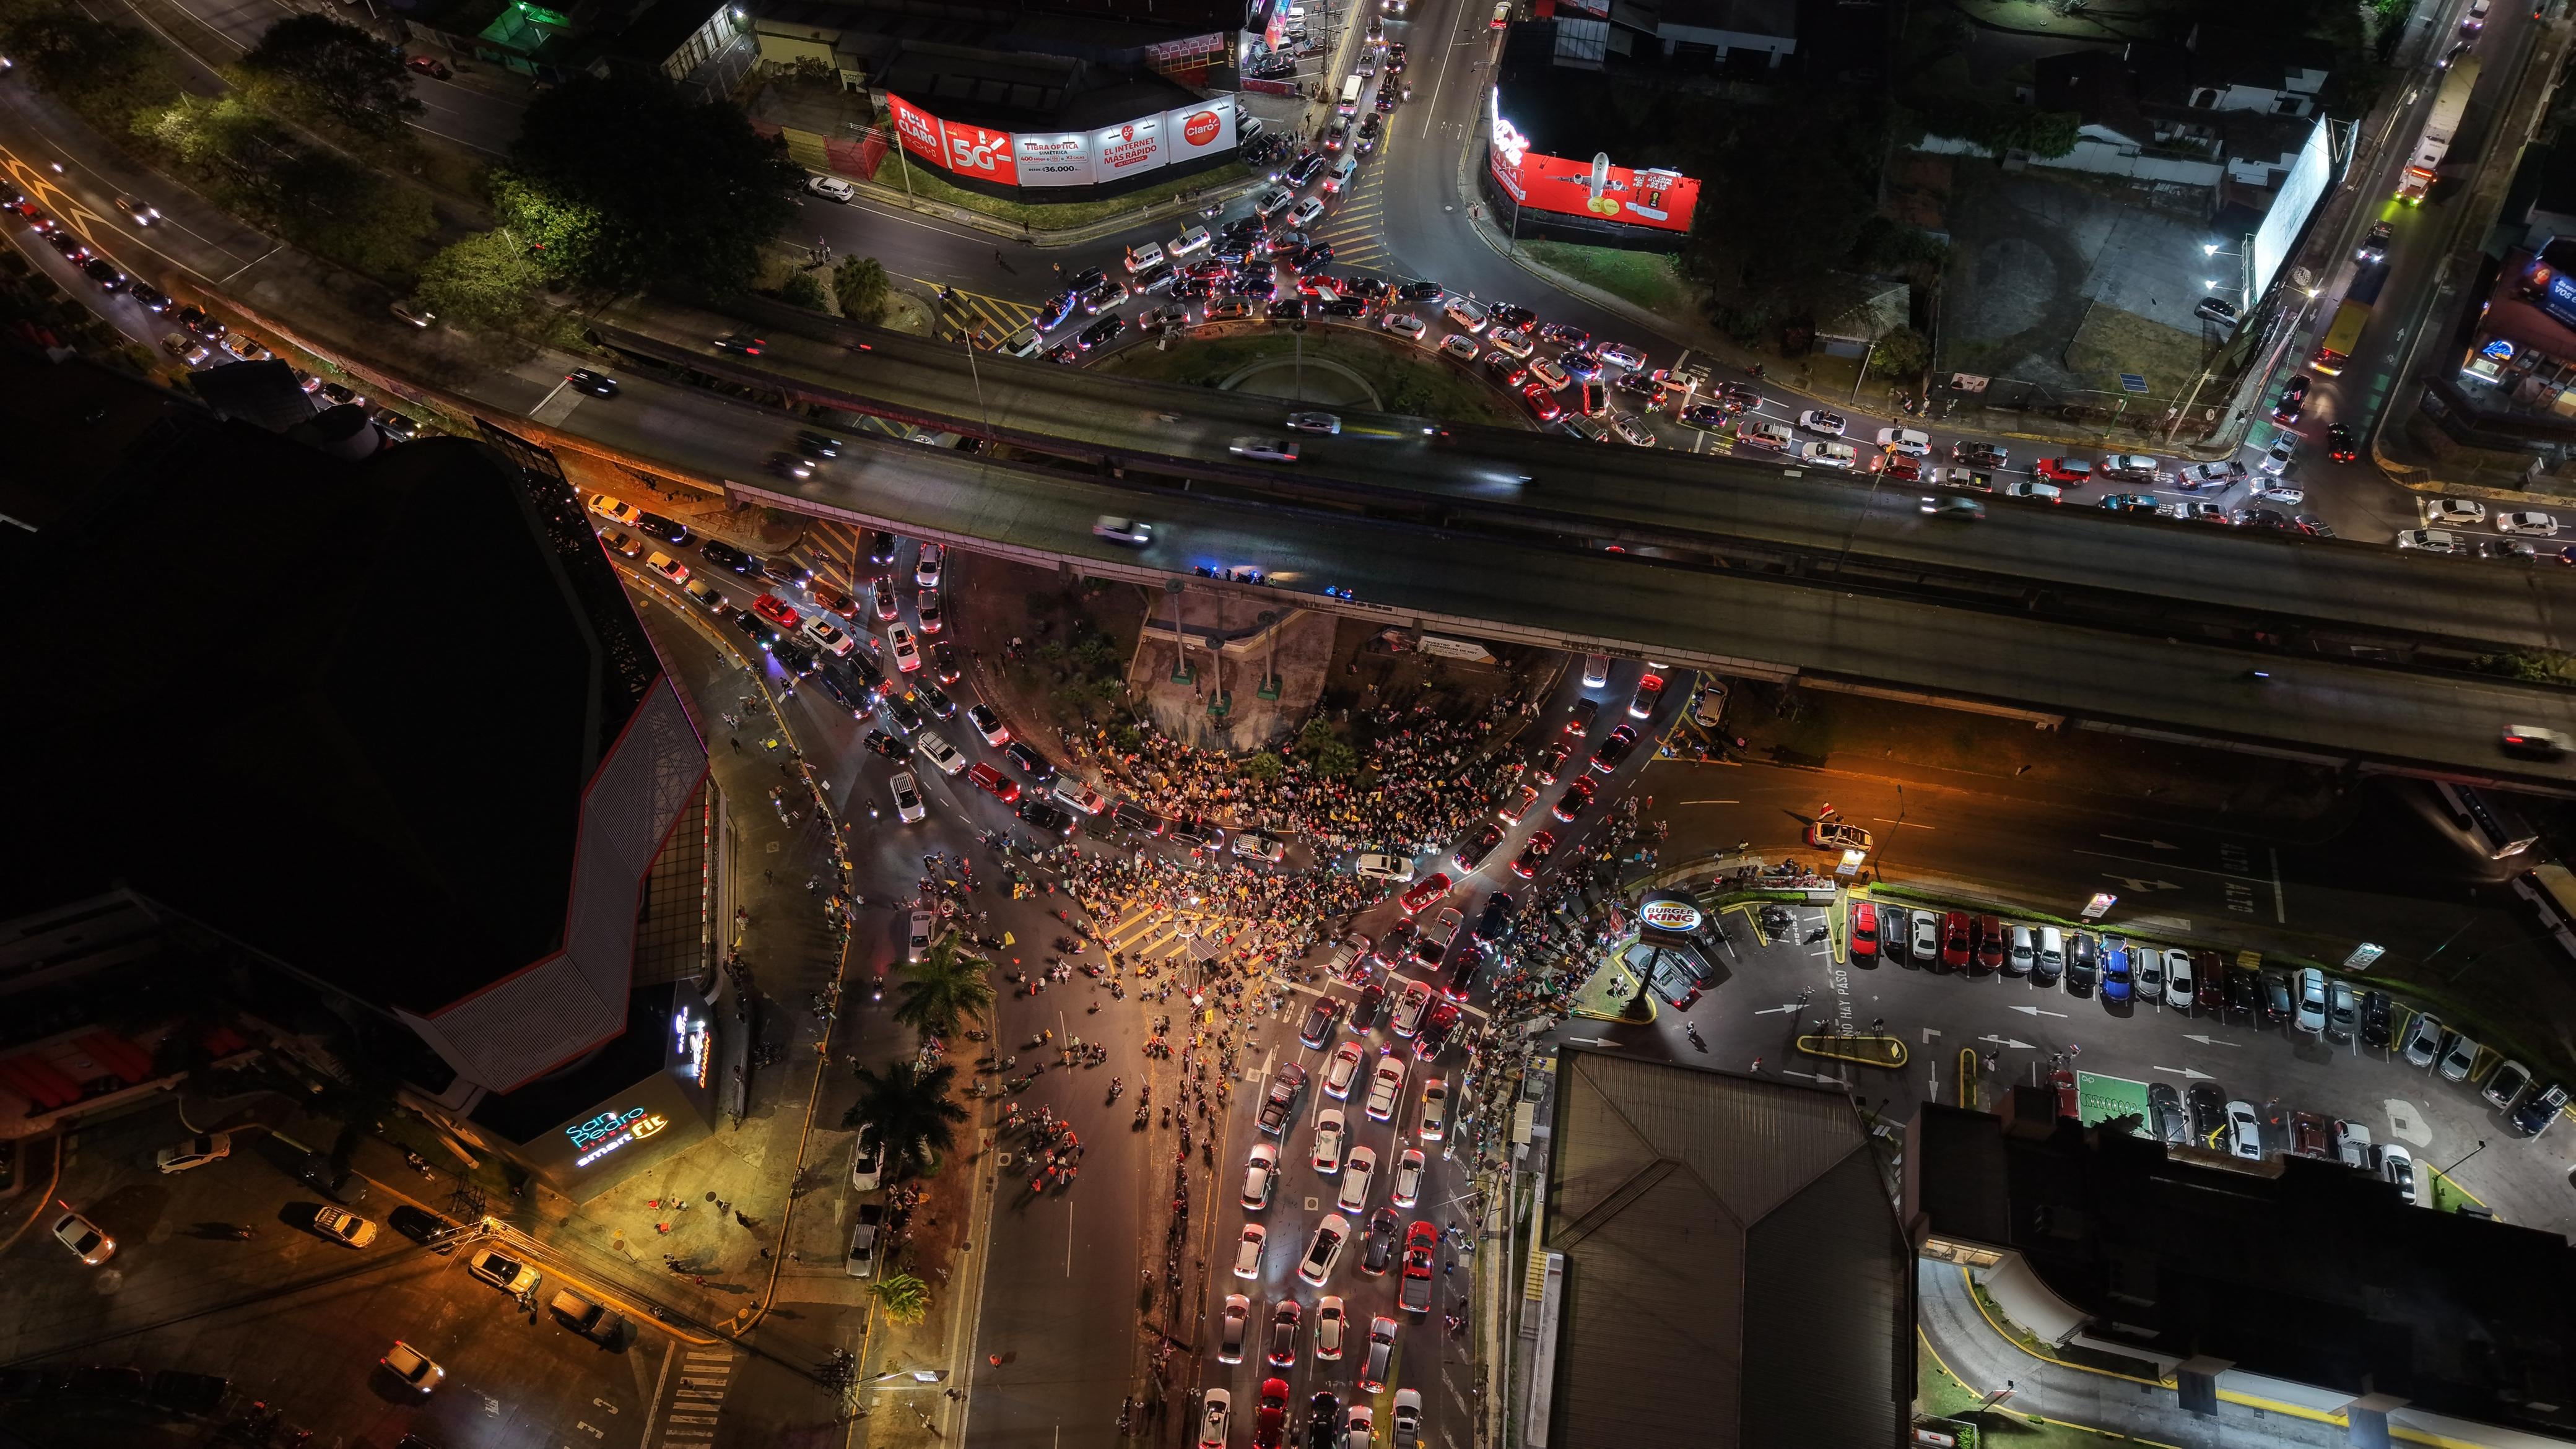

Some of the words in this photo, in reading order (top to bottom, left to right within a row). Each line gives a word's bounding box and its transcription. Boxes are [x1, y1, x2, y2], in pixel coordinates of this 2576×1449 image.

[898, 118, 938, 147] CLARO
[900, 107, 929, 133] FULL
[1187, 121, 1215, 136] Claro
[953, 138, 995, 170] 5G
[1104, 147, 1113, 156] EL
[1115, 137, 1155, 152] INTERNET
[1104, 152, 1124, 164] MÁS
[1125, 145, 1157, 159] RÁPIDO
[1647, 913, 1695, 922] KING
[1835, 970, 1849, 995] PASO
[1839, 1000, 1852, 1019] HAY
[1842, 1023, 1853, 1037] NO
[566, 1112, 616, 1139] San
[571, 1108, 643, 1148] Pedro
[577, 1133, 633, 1167] smart
